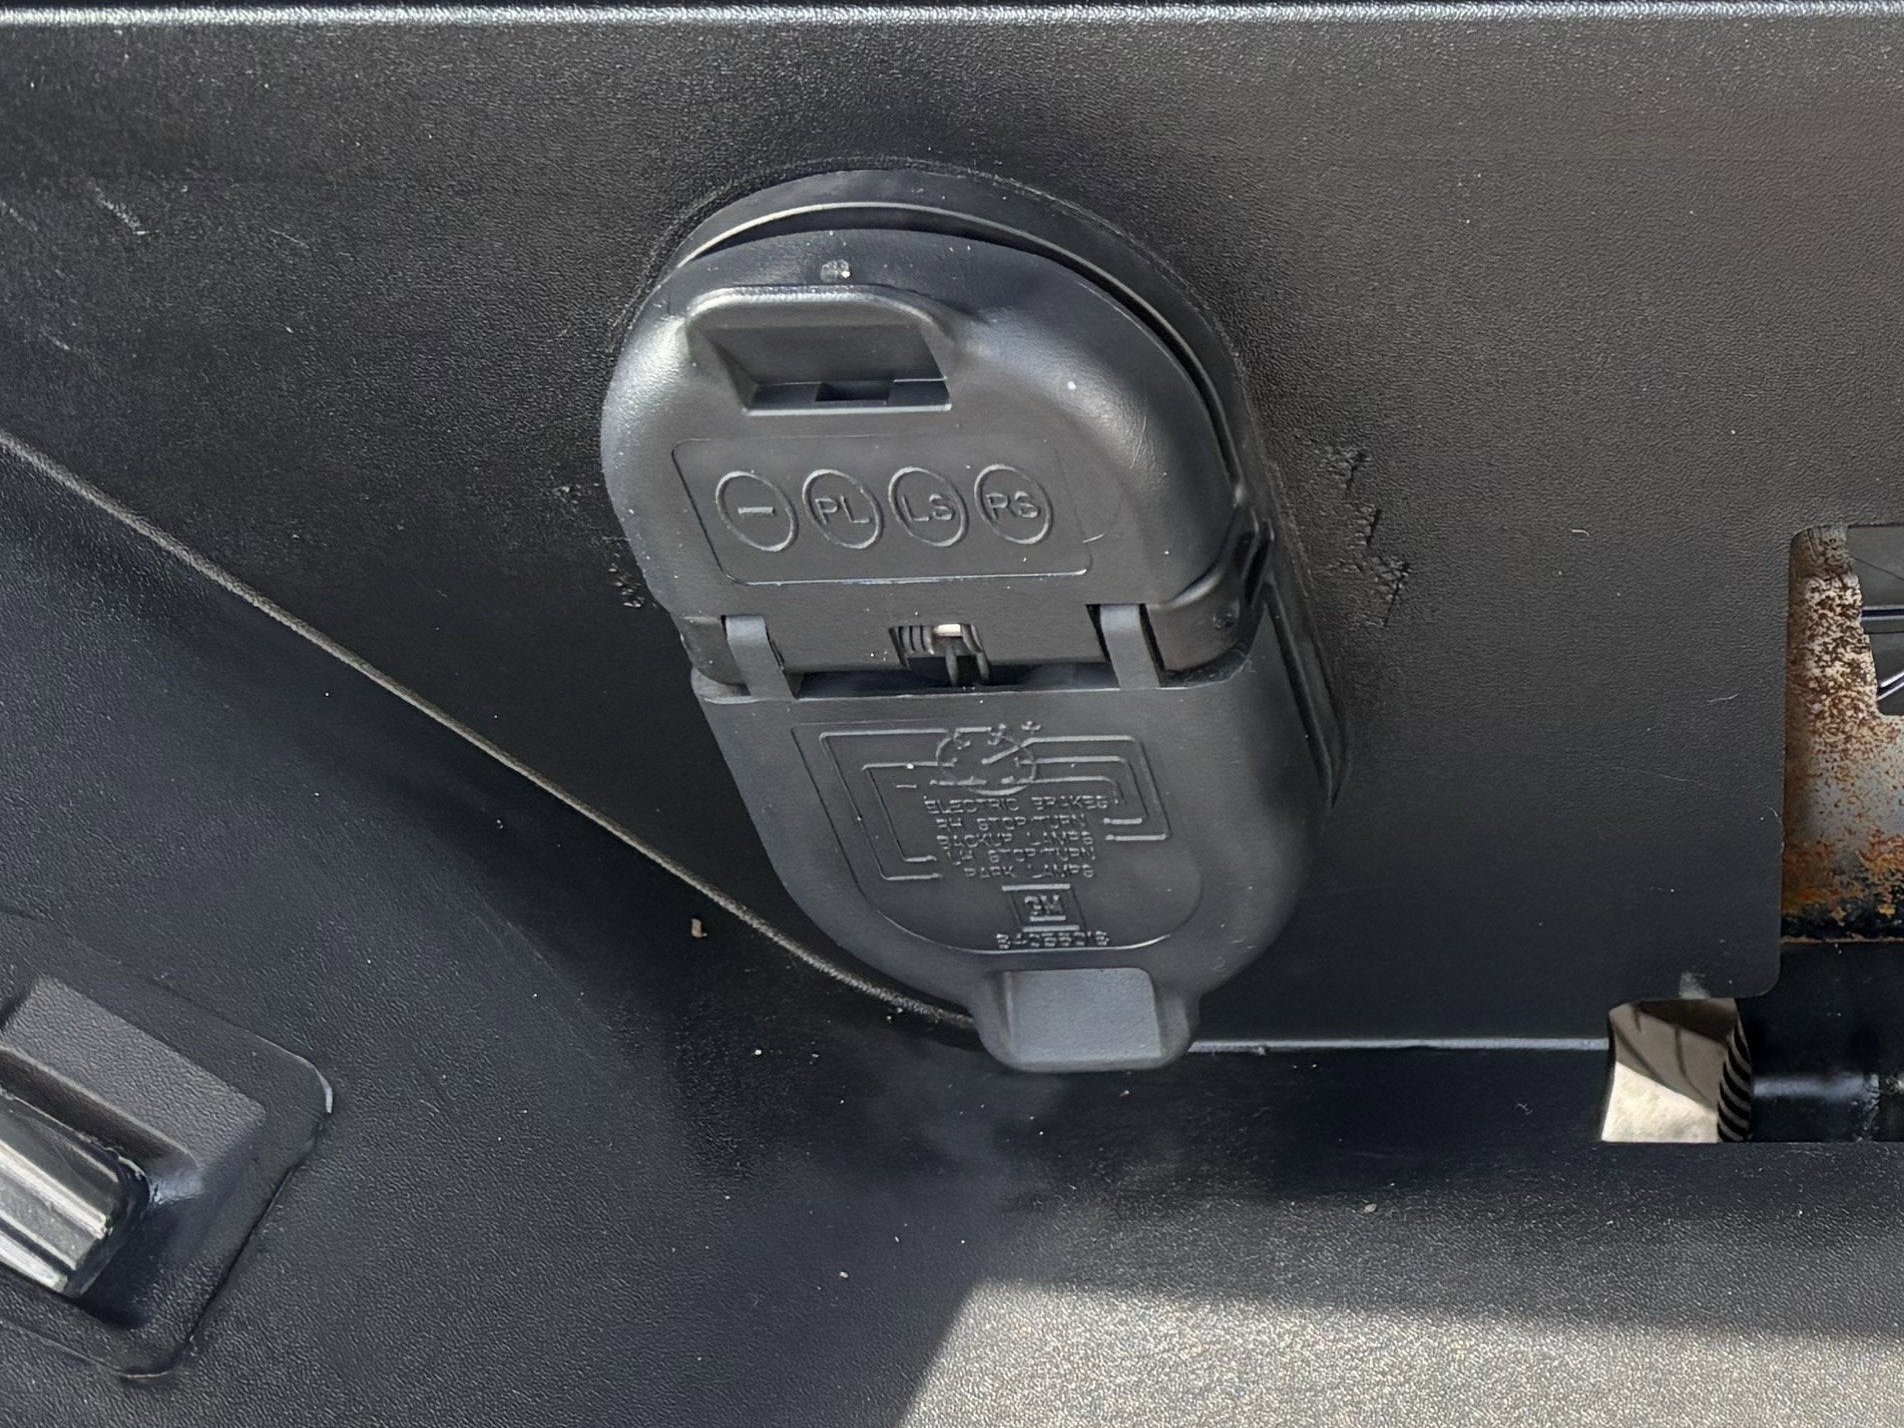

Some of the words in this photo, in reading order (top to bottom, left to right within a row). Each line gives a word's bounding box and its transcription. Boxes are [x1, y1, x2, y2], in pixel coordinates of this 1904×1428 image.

[814, 495, 870, 525] PL
[901, 493, 952, 523] LS
[985, 491, 1038, 519] RS
[924, 798, 1019, 814] ELECTRIC
[1031, 795, 1109, 810] BRAKES
[936, 833, 1013, 850] BACKUP
[1026, 830, 1094, 846] LAMPS
[963, 866, 1015, 879] PARK
[1027, 863, 1095, 879] LAMPS
[1023, 894, 1063, 917] GM
